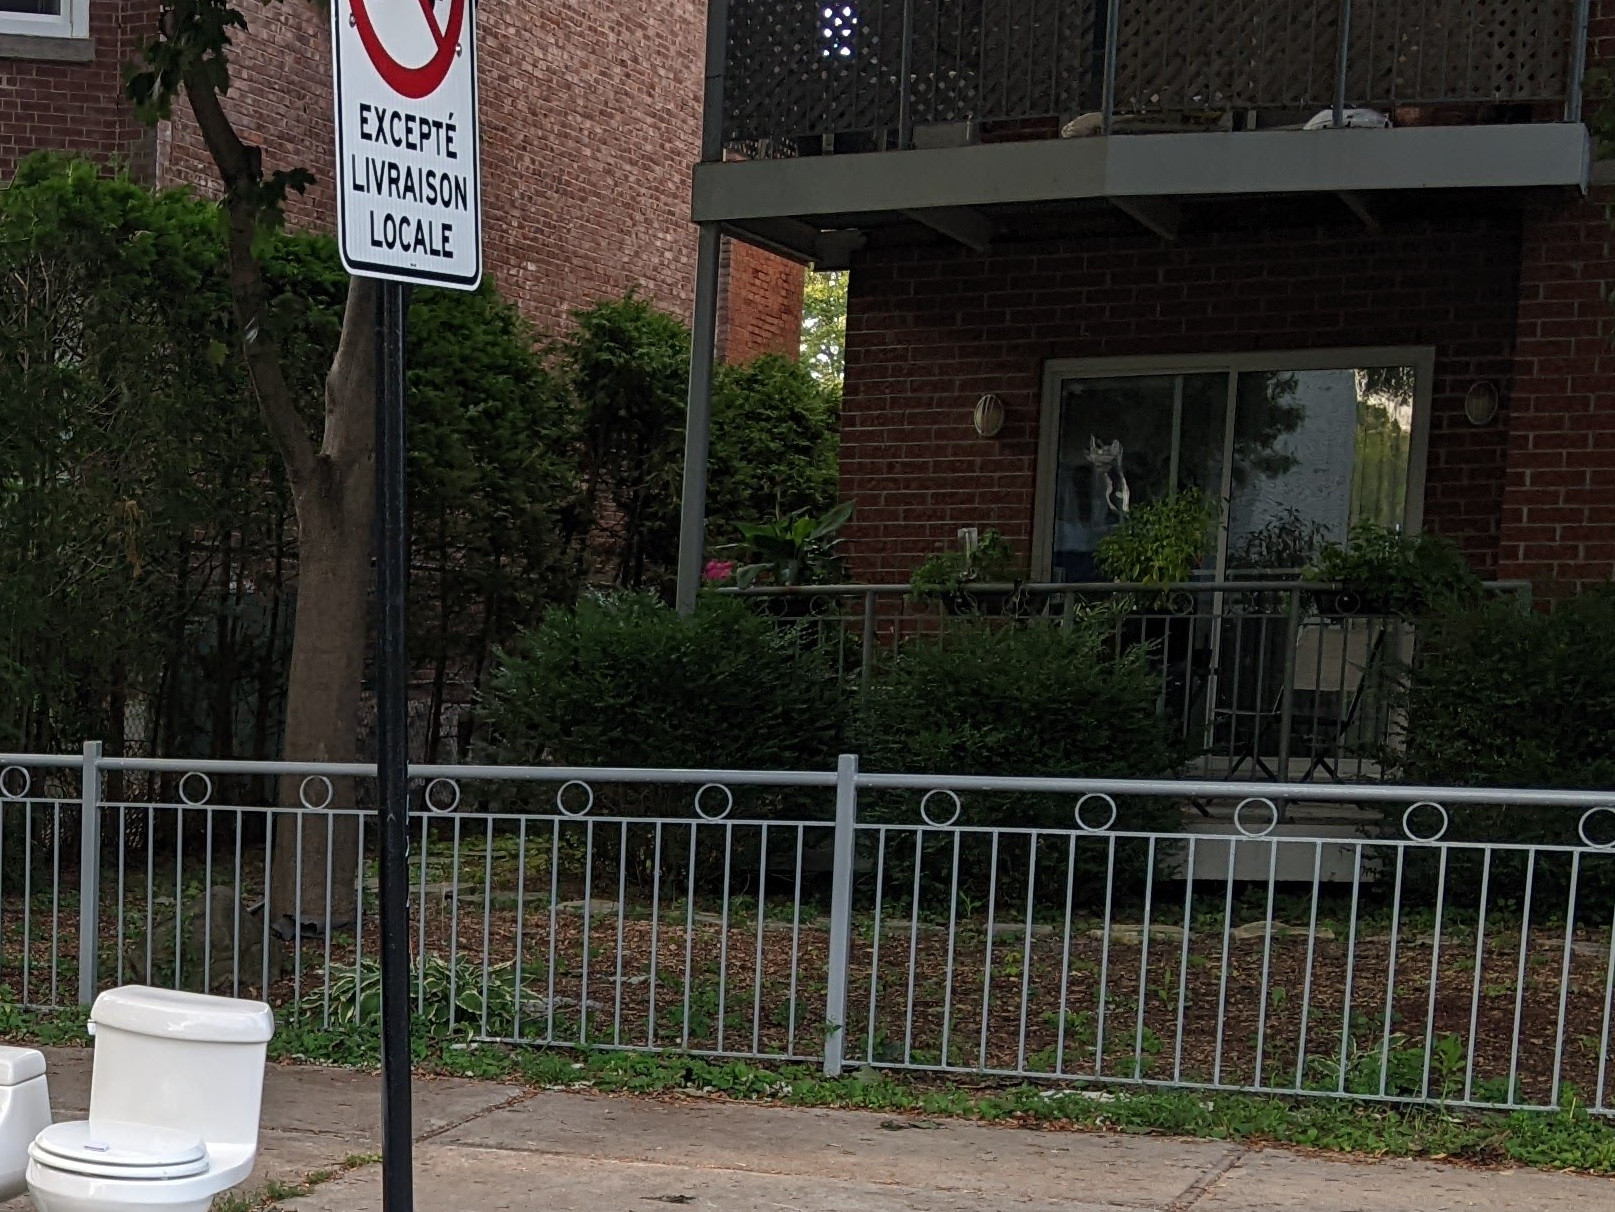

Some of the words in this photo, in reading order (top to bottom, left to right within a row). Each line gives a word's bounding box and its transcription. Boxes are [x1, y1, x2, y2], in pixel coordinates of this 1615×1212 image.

[359, 102, 457, 159] EXCEPTÉ
[351, 153, 468, 212] LIVRAISON
[369, 209, 454, 259] LOCALE
